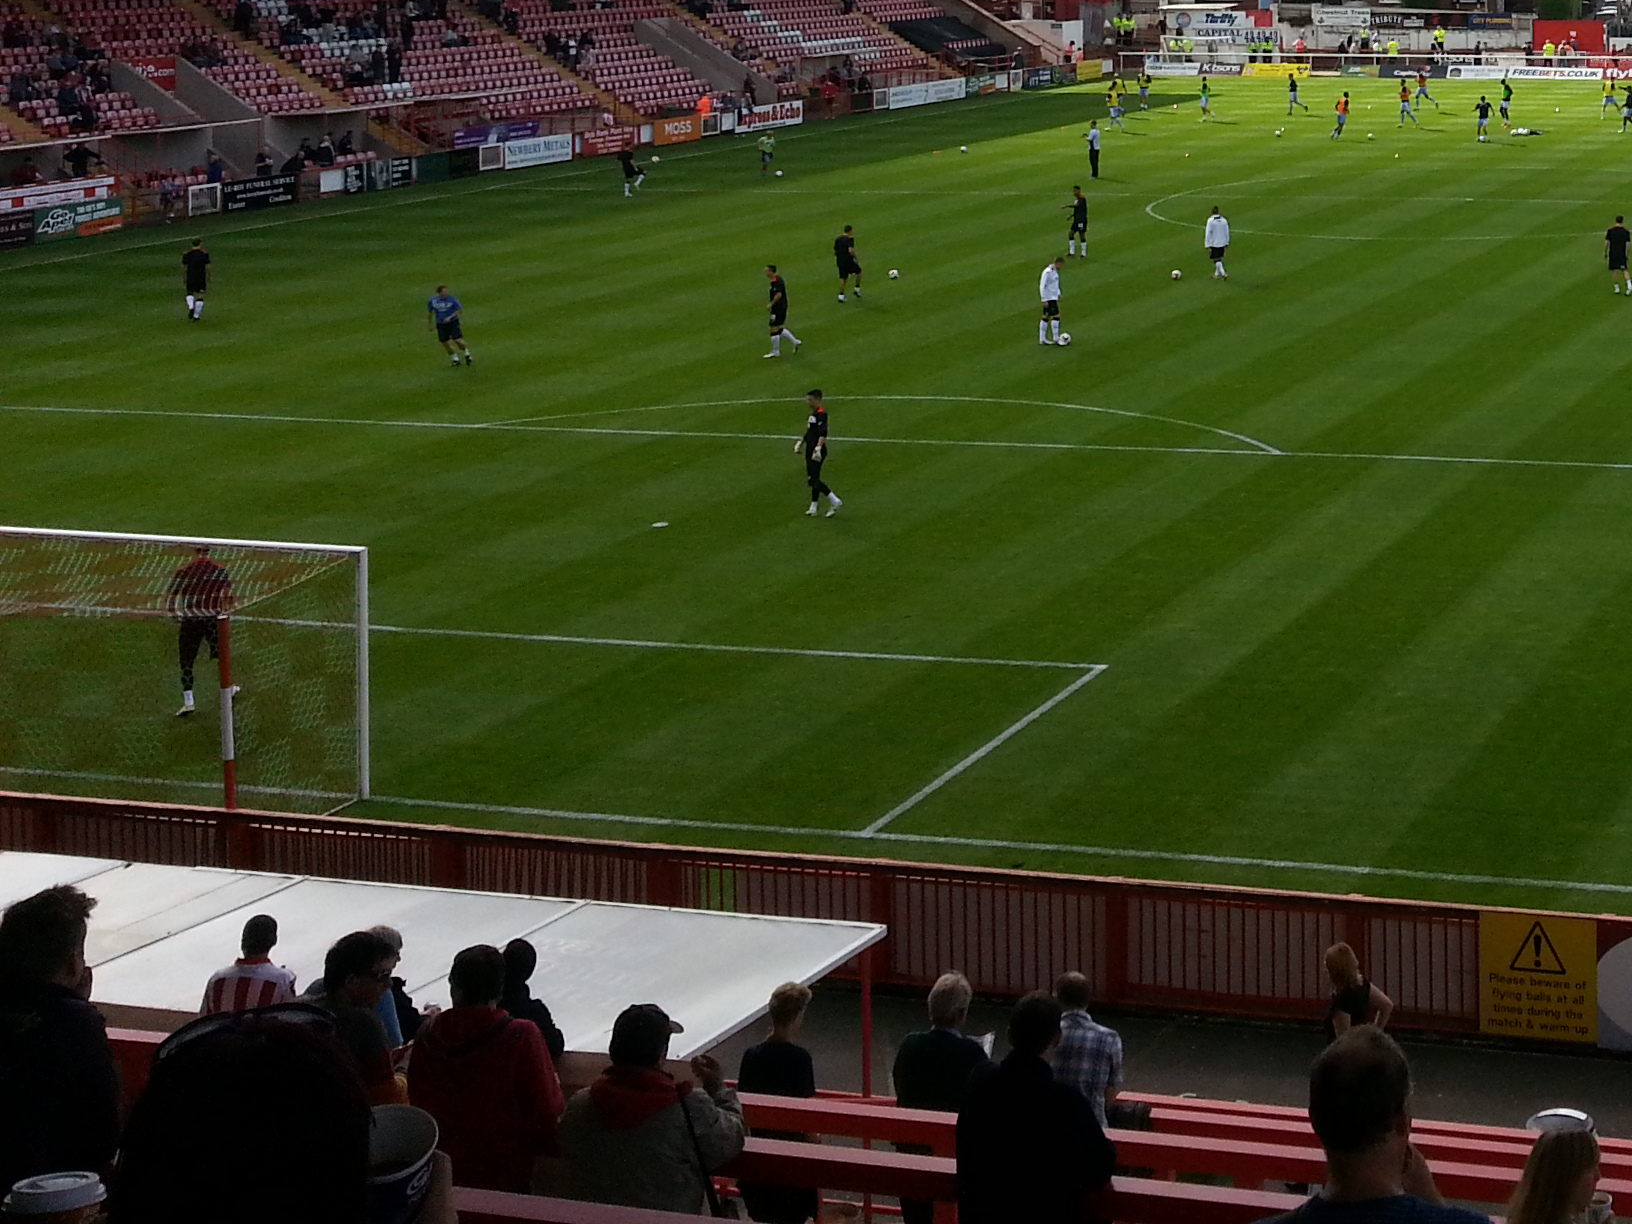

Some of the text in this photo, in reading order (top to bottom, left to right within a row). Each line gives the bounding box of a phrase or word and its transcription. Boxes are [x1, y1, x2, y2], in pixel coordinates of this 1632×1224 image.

[1204, 13, 1238, 26] Thrifty
[1371, 15, 1401, 25] TRIBUTE
[1197, 29, 1243, 37] CAPITAL
[1512, 68, 1600, 78] FREEBETS.CO.UK
[772, 105, 779, 121] &
[779, 102, 801, 120] Echo
[664, 120, 692, 136] MOSS
[543, 139, 571, 152] METALS
[49, 209, 68, 220] Go
[1489, 973, 1586, 990] Please beware of
[1492, 988, 1584, 1005] flying balls at all
[1494, 1003, 1583, 1020] times during the
[1488, 1018, 1522, 1029] match
[1526, 1019, 1534, 1029] &
